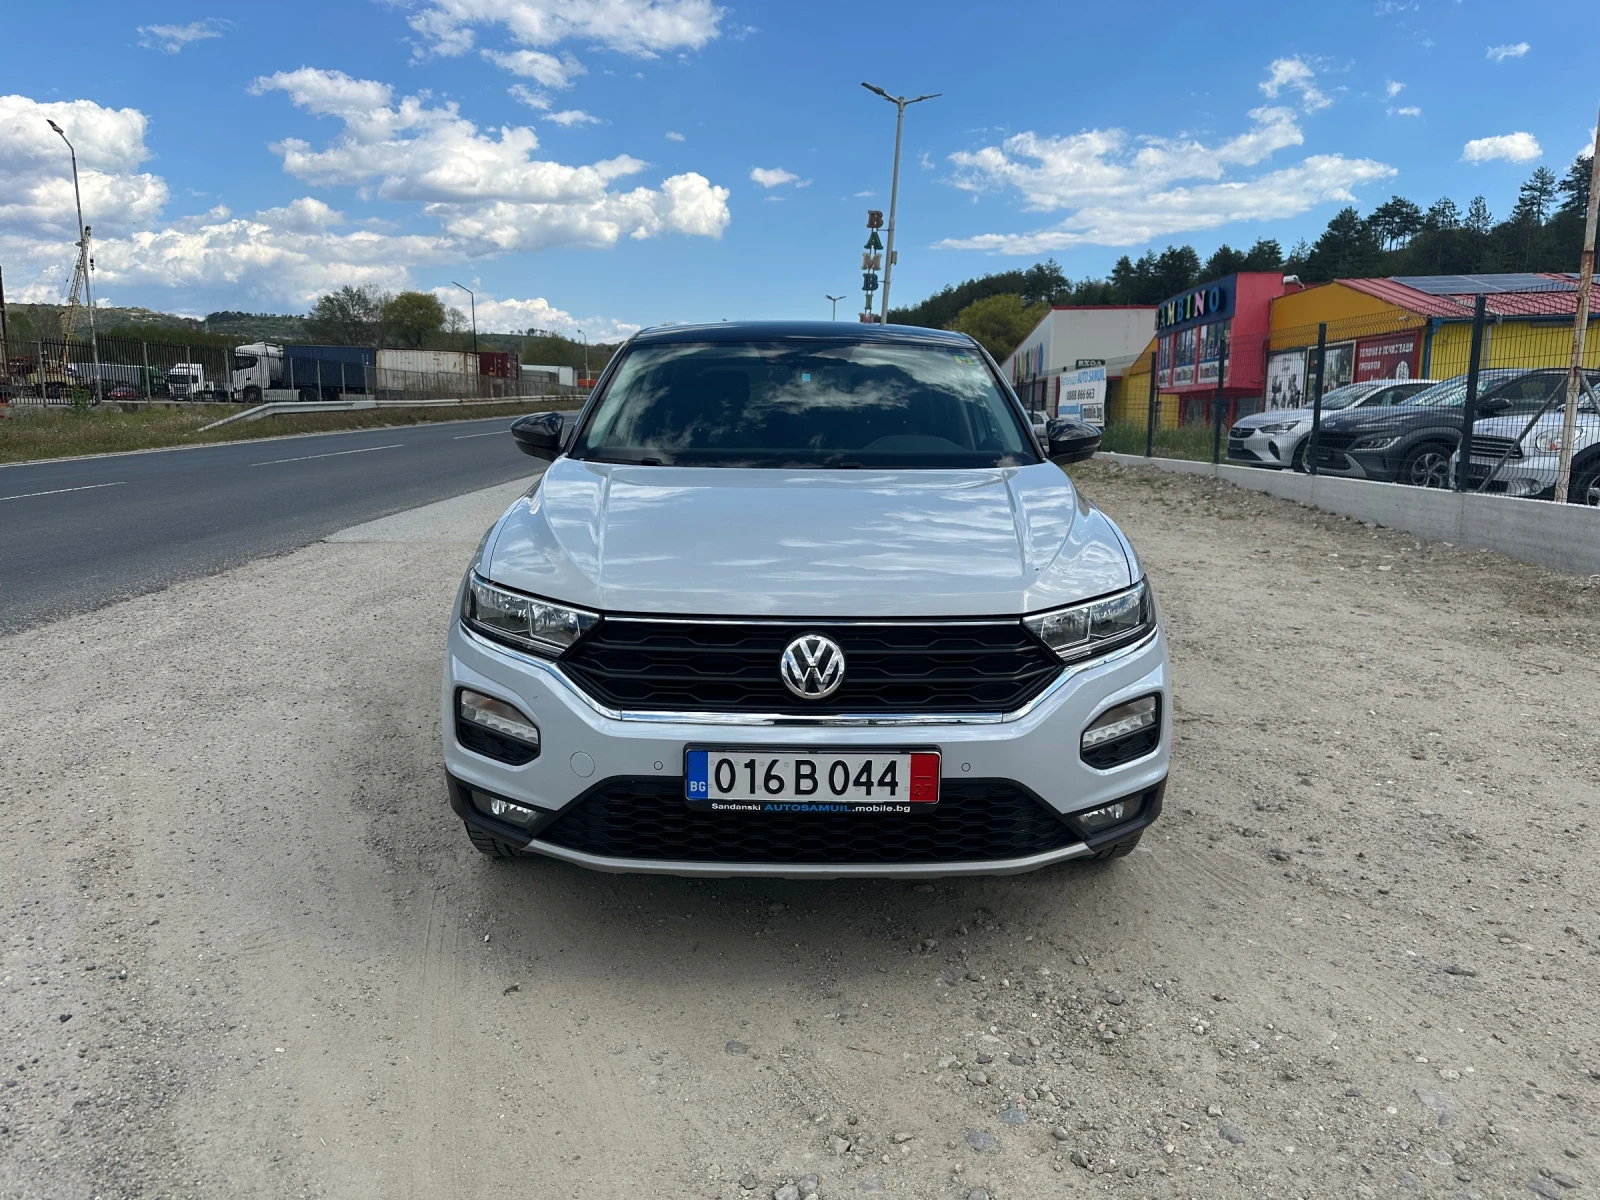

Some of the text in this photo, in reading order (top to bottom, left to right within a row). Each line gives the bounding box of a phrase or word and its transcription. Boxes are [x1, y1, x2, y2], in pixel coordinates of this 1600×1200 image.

[1154, 286, 1220, 331] BAMBINO
[690, 781, 706, 792] BG
[711, 802, 761, 811] Sandanski
